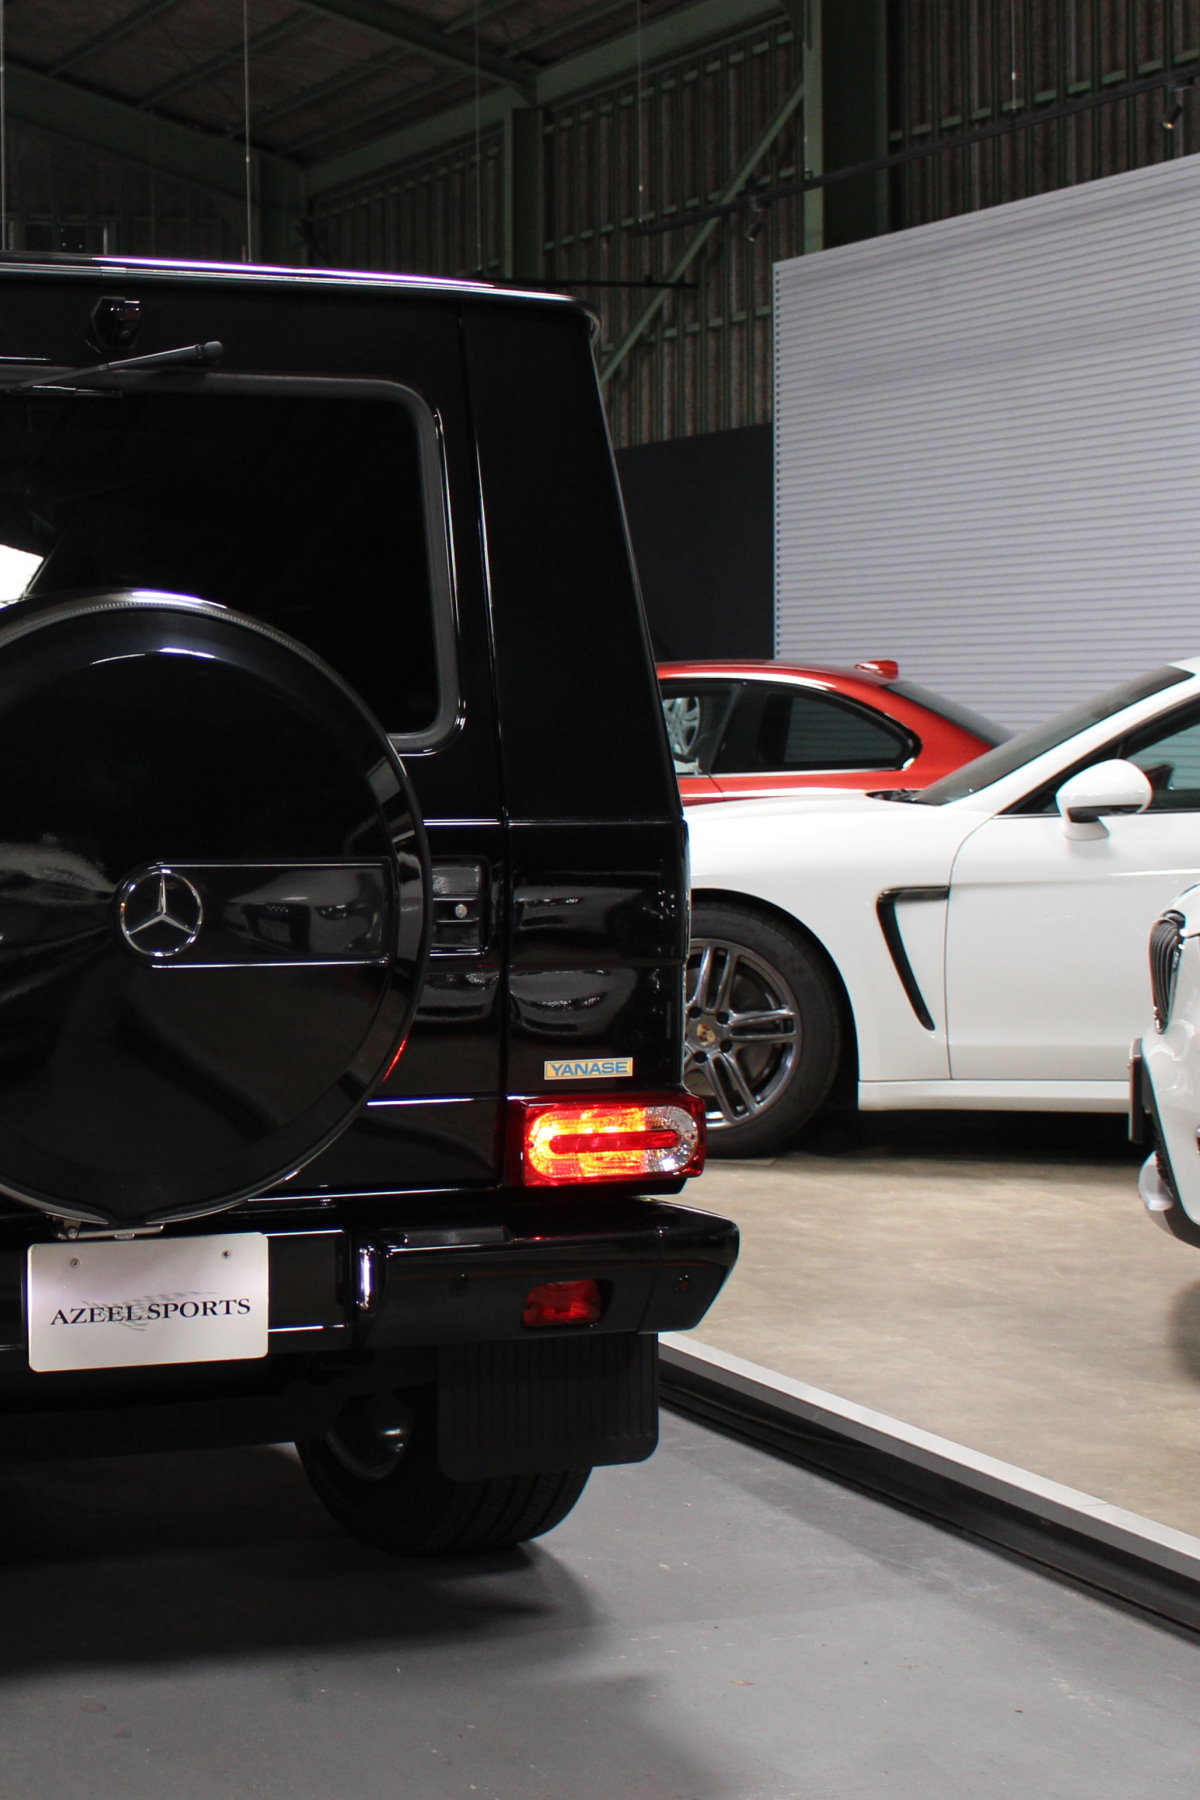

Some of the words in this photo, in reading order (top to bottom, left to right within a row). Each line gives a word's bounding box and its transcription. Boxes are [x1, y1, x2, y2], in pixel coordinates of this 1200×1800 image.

[551, 1061, 628, 1076] YANASE
[50, 1306, 143, 1325] AZEEL
[147, 1298, 251, 1320] SPORTS
